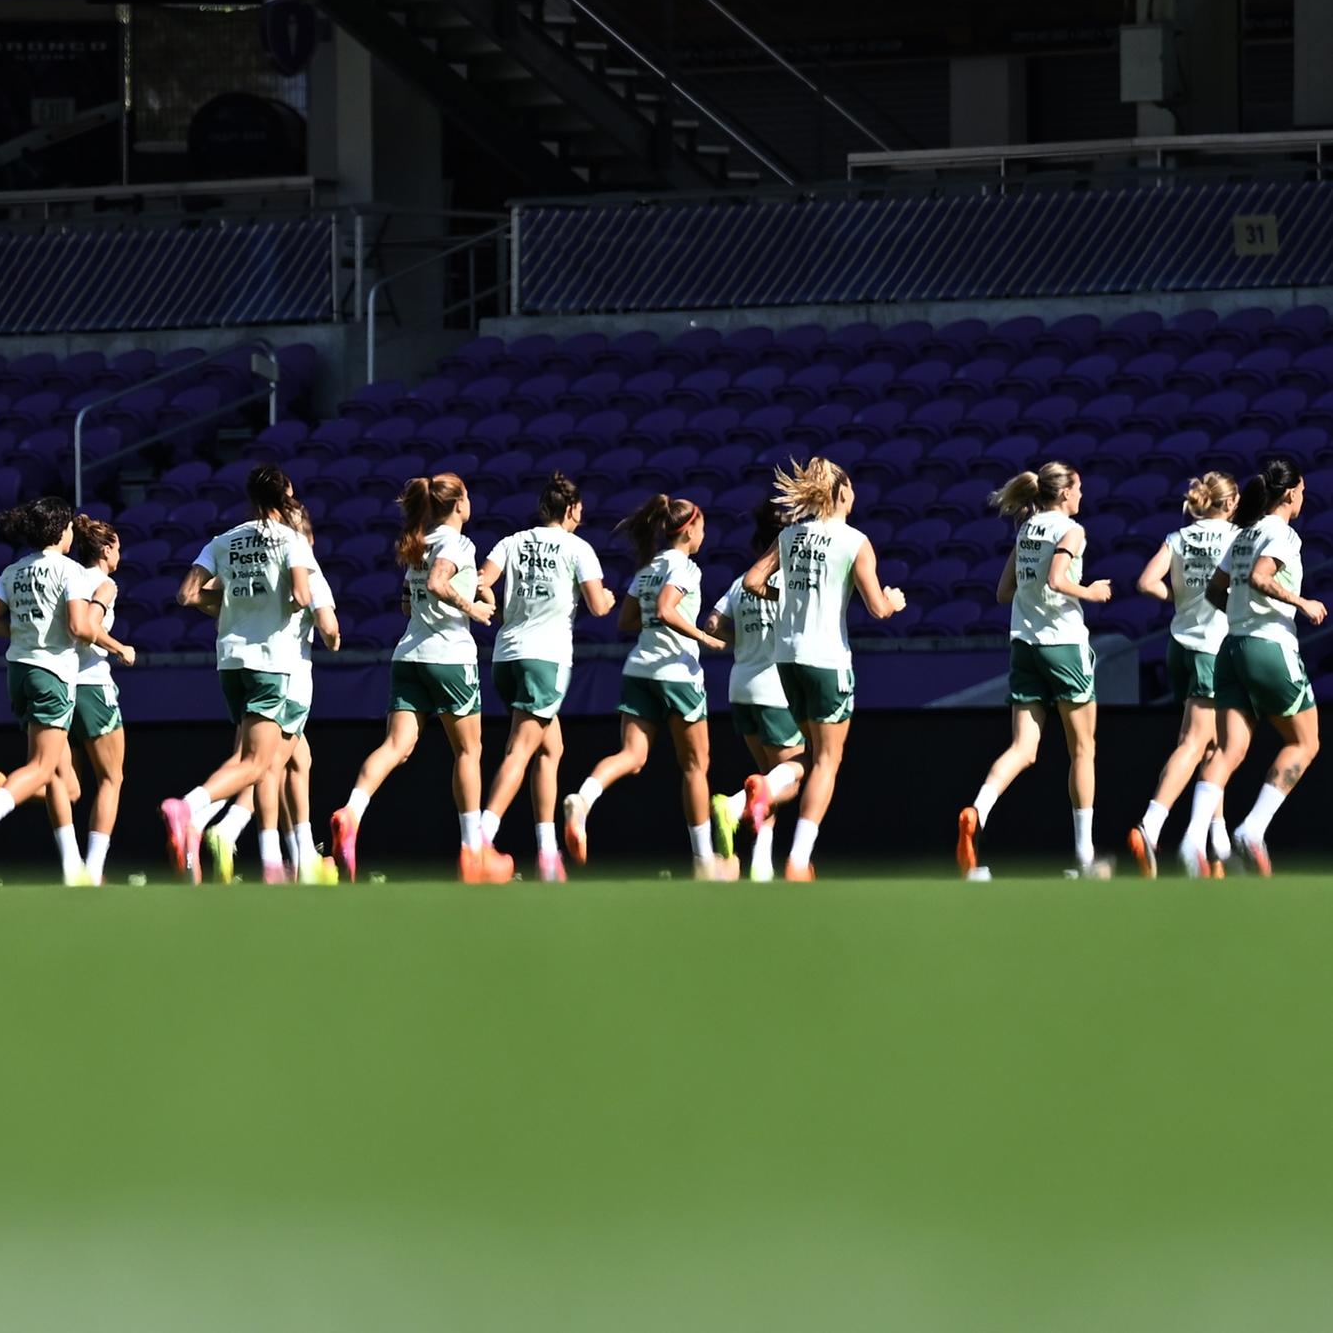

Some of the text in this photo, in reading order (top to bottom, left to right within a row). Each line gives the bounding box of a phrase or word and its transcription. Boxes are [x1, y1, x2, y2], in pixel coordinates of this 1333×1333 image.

[1246, 224, 1265, 245] 31
[807, 533, 831, 547] TIM
[1199, 532, 1222, 542] TIM
[536, 541, 561, 555] TIM
[1020, 539, 1042, 551] oste
[229, 551, 268, 565] Poste
[790, 545, 826, 562] Poste
[519, 553, 557, 569] Poste
[788, 577, 805, 591] eni
